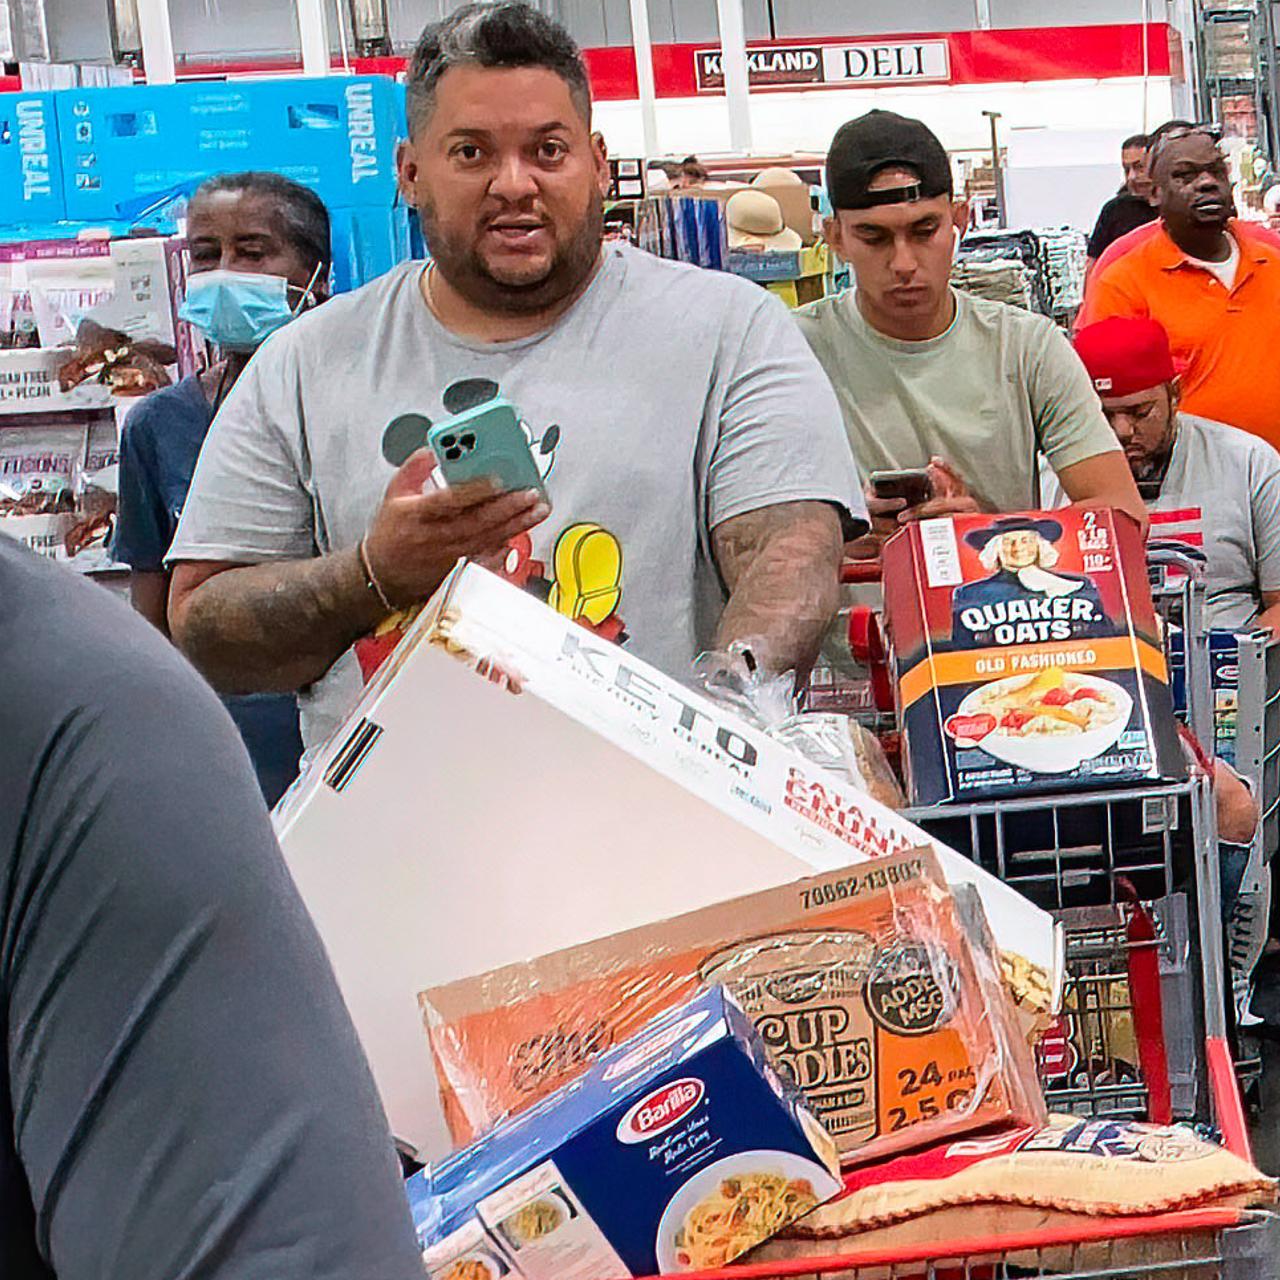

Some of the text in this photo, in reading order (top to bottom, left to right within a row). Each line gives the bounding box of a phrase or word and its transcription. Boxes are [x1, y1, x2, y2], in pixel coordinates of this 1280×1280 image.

[704, 46, 926, 78] KKLAND DELI
[16, 99, 50, 201] UNREAL
[346, 82, 379, 184] UNREAL
[994, 619, 1071, 645] OATS
[975, 650, 1097, 673] OLD FASHIONED
[560, 631, 758, 767] KETO
[787, 766, 912, 850] CATALIN
[880, 973, 935, 1013] ADDE
[756, 1007, 848, 1052] CUP
[776, 1040, 871, 1090] ODLES
[898, 1061, 942, 1095] 24
[637, 1082, 697, 1131] Barilla
[888, 1099, 940, 1130] 2.5
